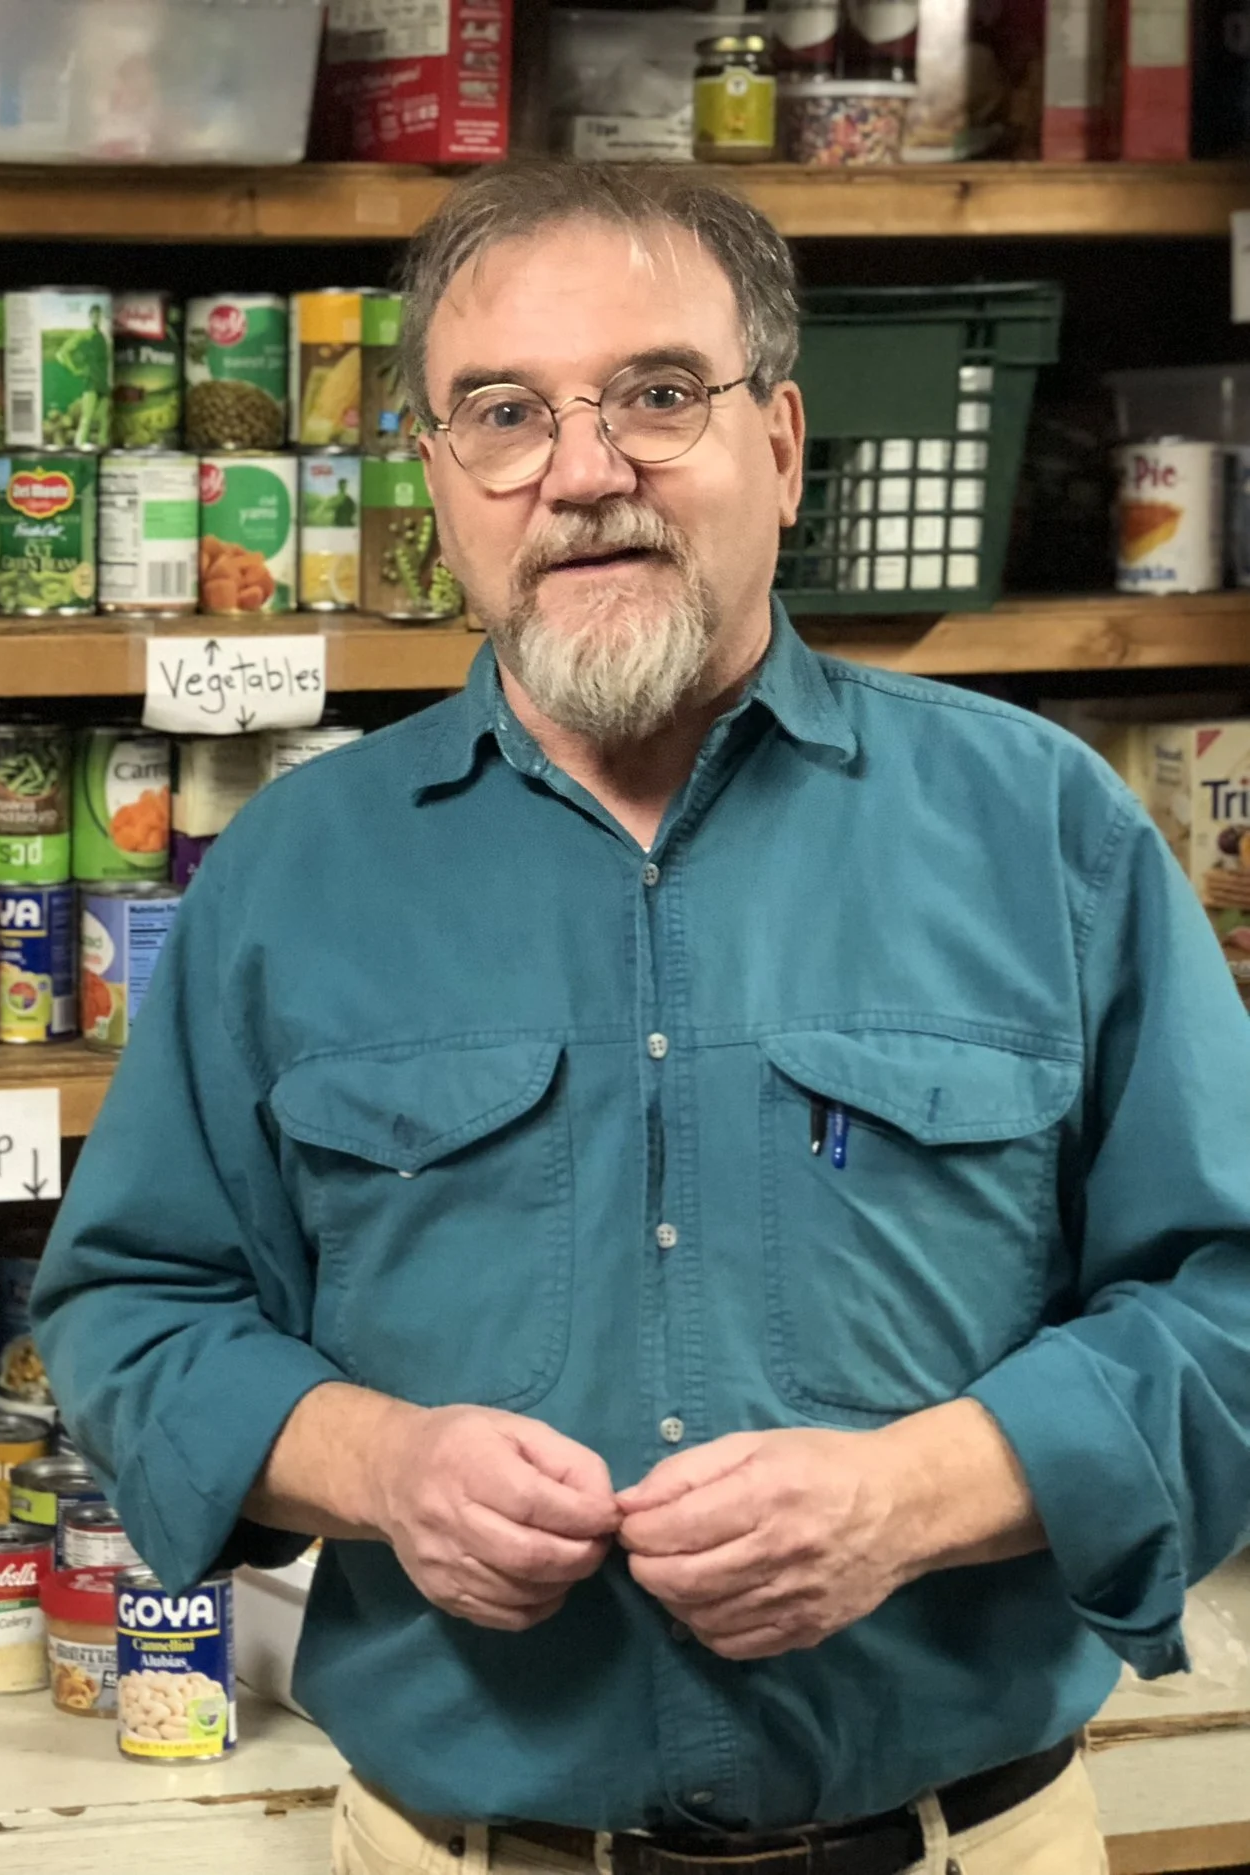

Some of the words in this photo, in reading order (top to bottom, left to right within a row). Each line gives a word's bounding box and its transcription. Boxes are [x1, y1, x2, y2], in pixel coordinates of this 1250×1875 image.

[1133, 455, 1178, 489] Pie
[159, 652, 321, 714] Vegetables
[119, 1593, 216, 1628] GOYA
